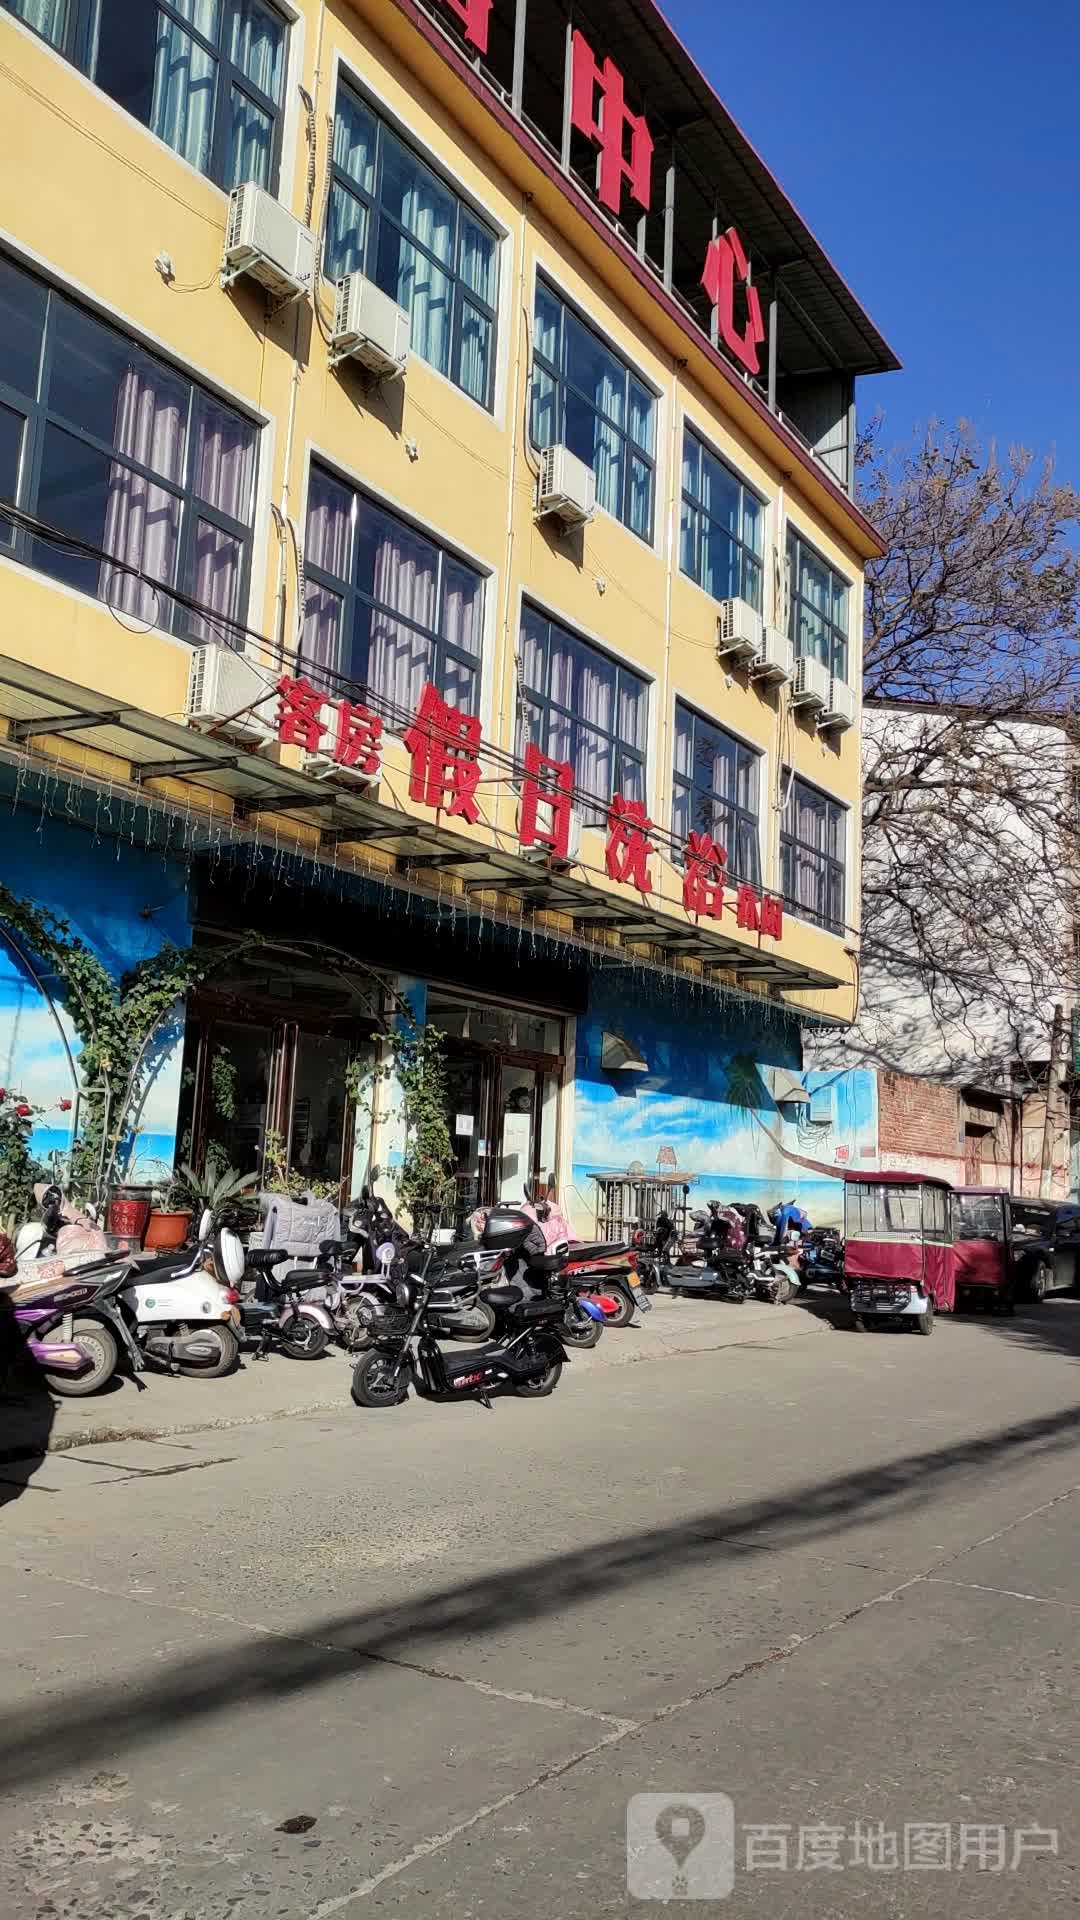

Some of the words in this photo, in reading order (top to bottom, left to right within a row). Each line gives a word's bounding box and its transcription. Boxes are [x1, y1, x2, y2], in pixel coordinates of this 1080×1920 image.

[275, 674, 384, 775] 客房
[403, 681, 728, 921] 假日洗浴
